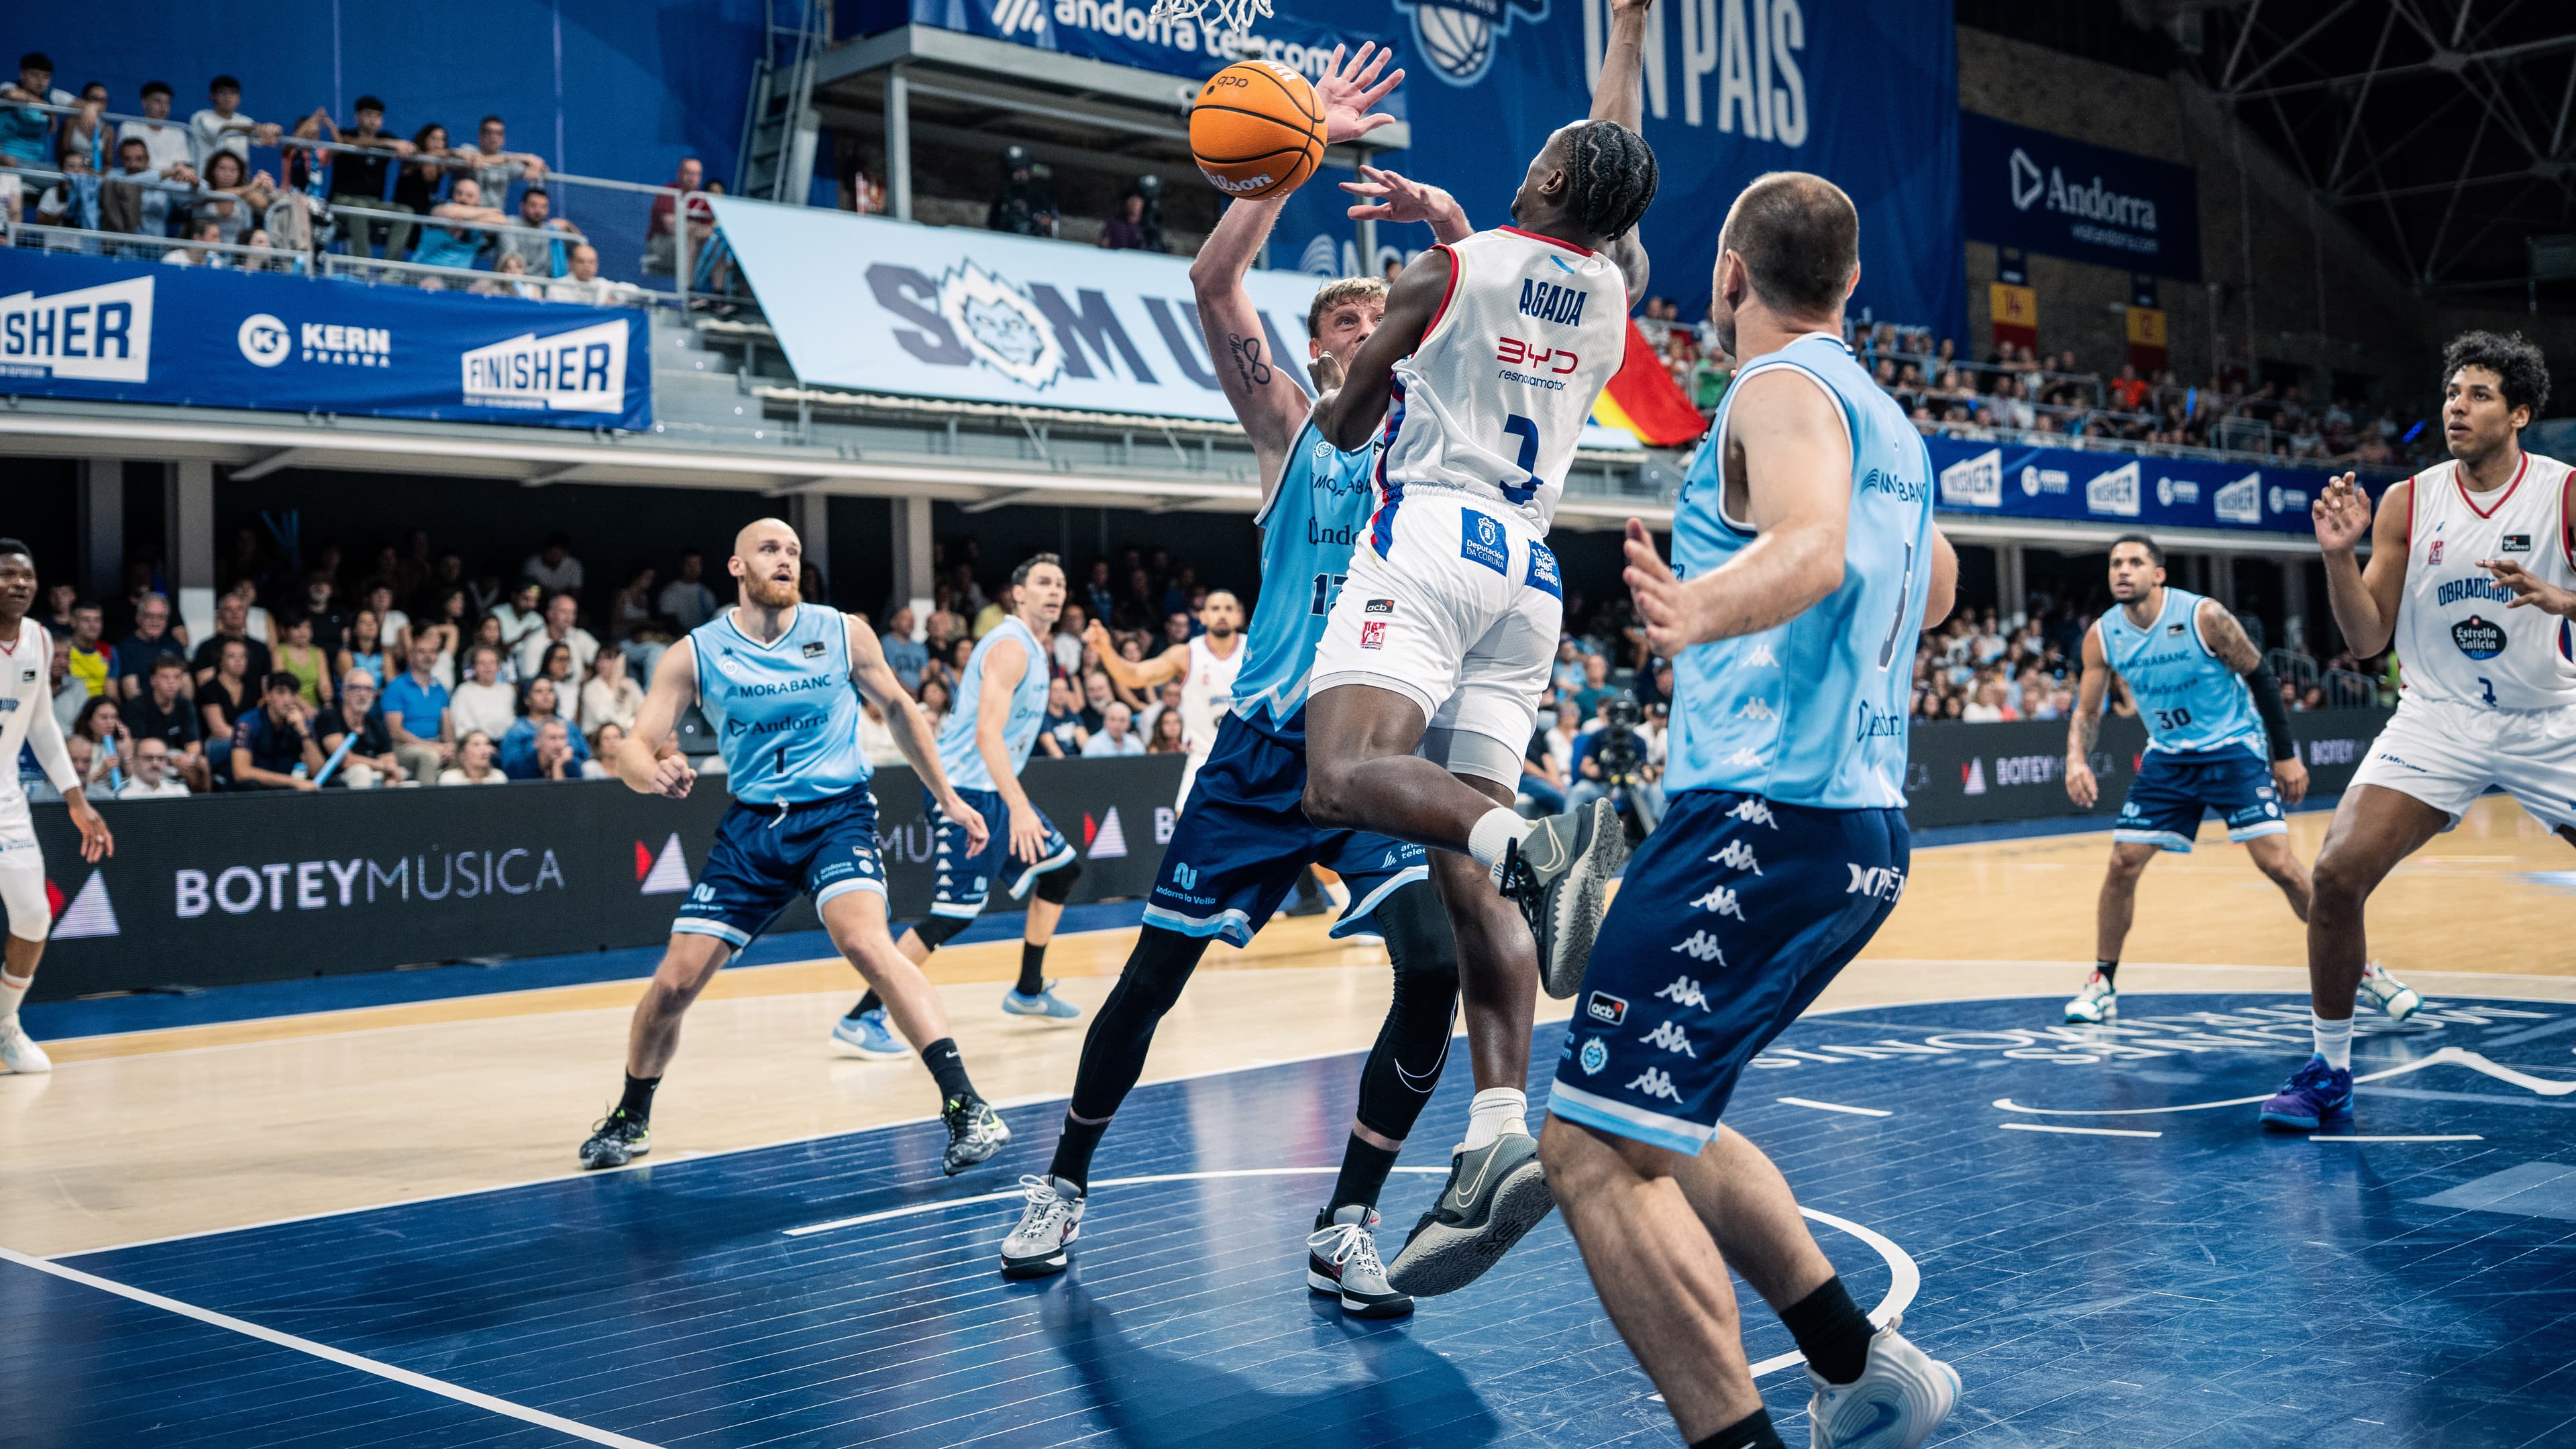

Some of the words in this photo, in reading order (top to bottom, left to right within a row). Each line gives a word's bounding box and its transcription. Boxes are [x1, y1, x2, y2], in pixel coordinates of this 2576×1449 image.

[2046, 166, 2157, 231] Andorra
[1519, 278, 1587, 327] AGADA
[0, 301, 132, 359] SHER
[865, 256, 1160, 391] SM
[302, 323, 390, 354] KERN
[471, 343, 610, 391] FINISHER
[1497, 337, 1578, 374] BYD
[1498, 369, 1566, 392] resnovamotor
[1466, 547, 1477, 556] DA
[1478, 551, 1504, 569] CORUÑA
[1467, 539, 1505, 561] Deputación
[1366, 604, 1387, 612] acb
[2457, 627, 2497, 639] Estrella
[2458, 638, 2496, 649] Galicia
[740, 674, 832, 698] MORABANC
[751, 712, 829, 735] Andorra
[2155, 708, 2192, 730] 30
[1156, 884, 1184, 898] Andorra
[1185, 892, 1191, 902] la
[1193, 895, 1216, 905] Vella
[1591, 1003, 1615, 1019] acb
